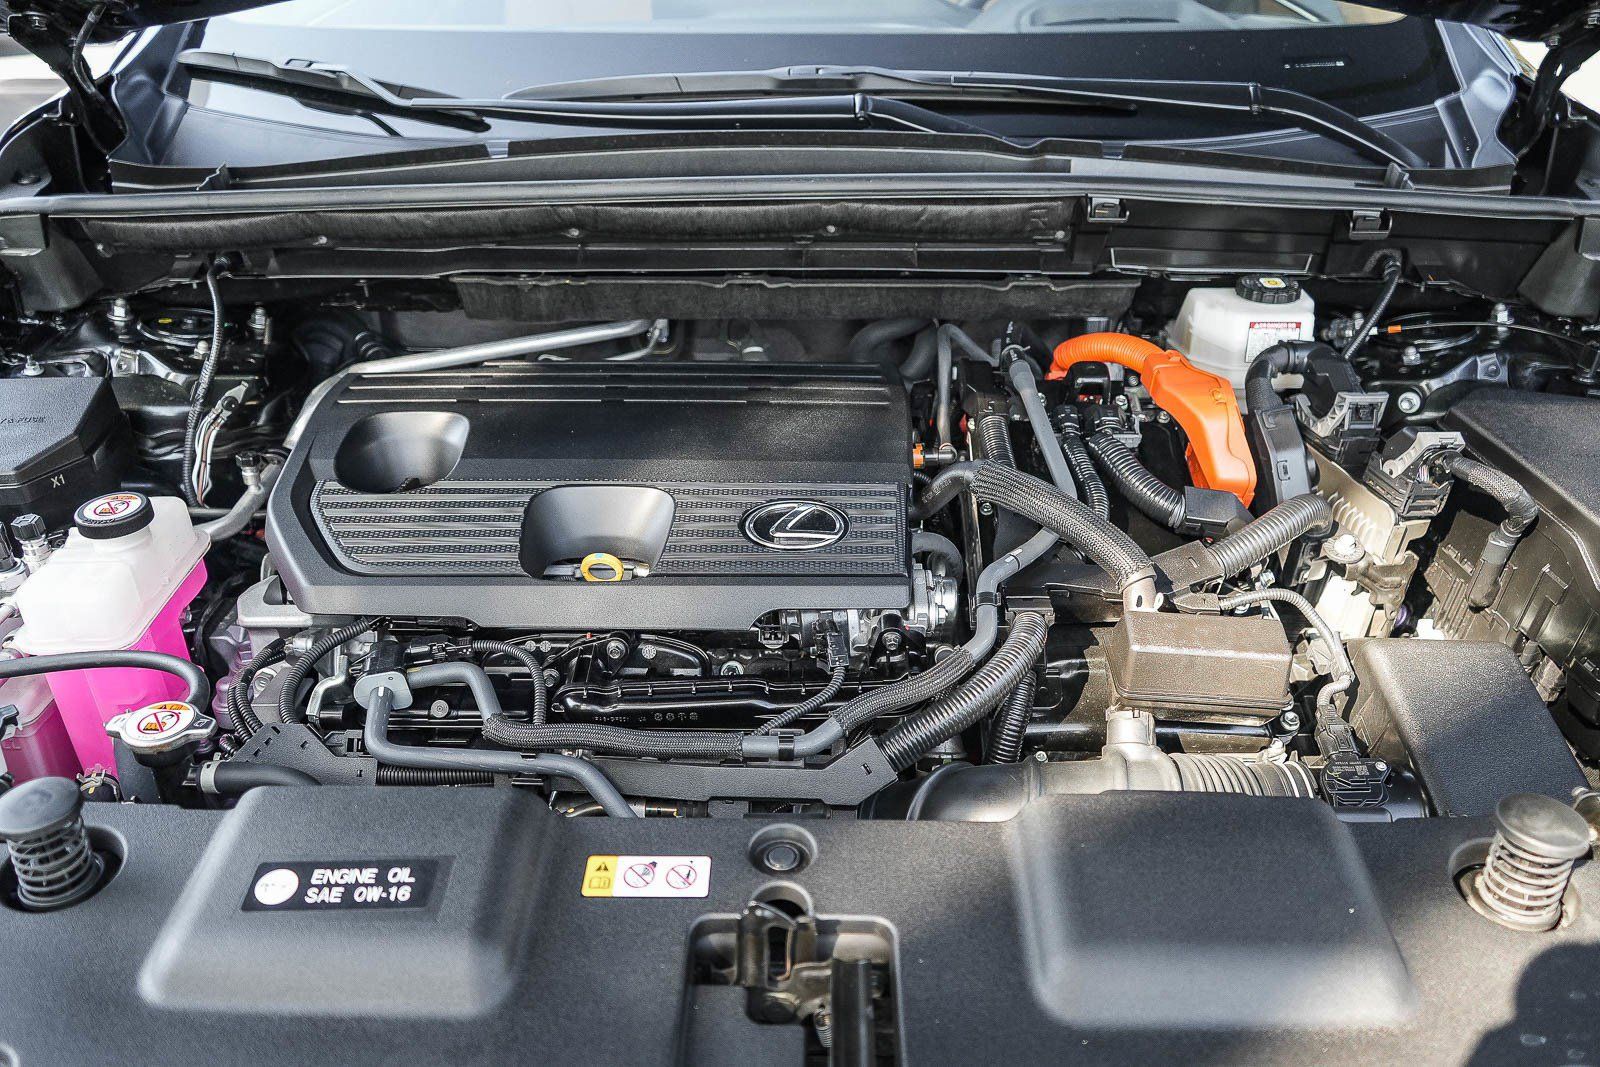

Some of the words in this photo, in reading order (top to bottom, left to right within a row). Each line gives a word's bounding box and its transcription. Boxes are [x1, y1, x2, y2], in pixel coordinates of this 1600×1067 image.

[50, 474, 65, 488] X1
[310, 867, 379, 885] ENGINE
[387, 866, 416, 883] OIL
[304, 886, 345, 904] SAE
[353, 885, 412, 903] 0W-16
